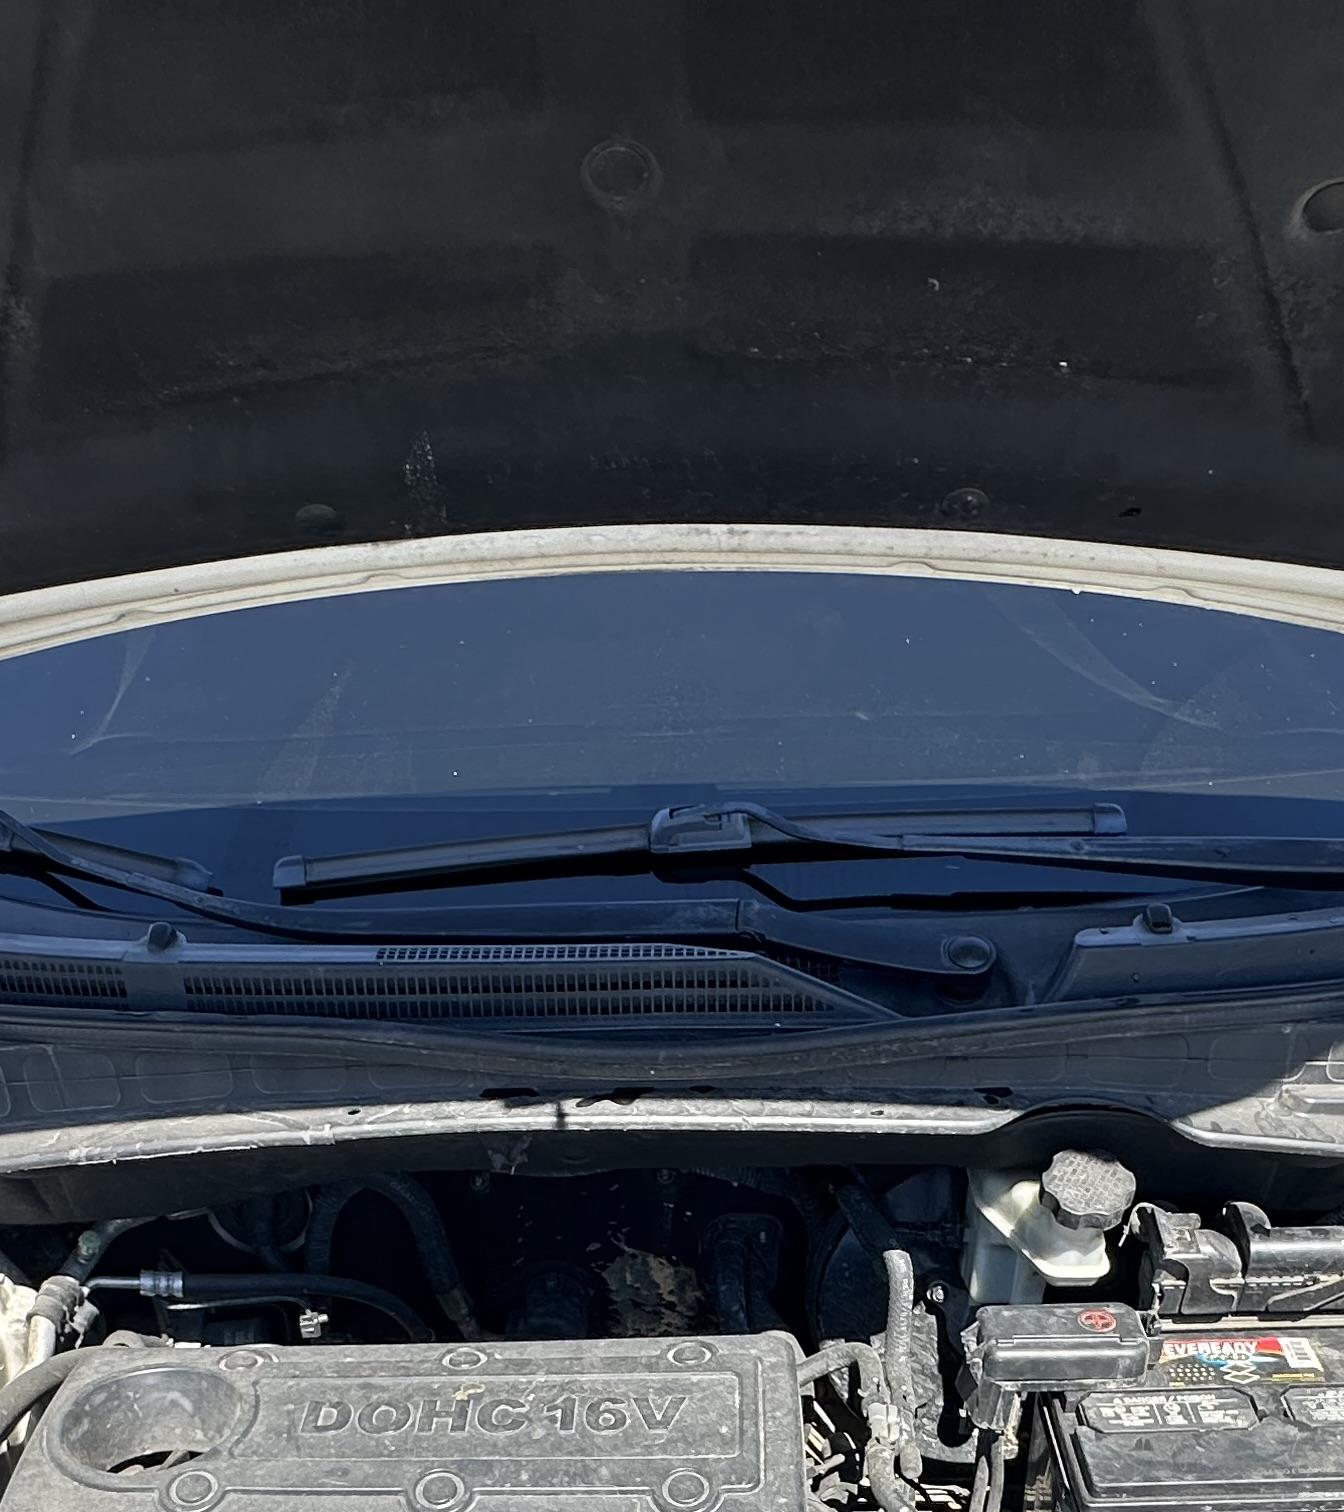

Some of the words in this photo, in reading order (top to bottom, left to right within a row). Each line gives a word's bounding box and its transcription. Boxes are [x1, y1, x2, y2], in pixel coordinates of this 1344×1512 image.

[1163, 1341, 1257, 1355] EVEREADY
[299, 1398, 529, 1435] DOHC
[544, 1395, 689, 1434] 16V
